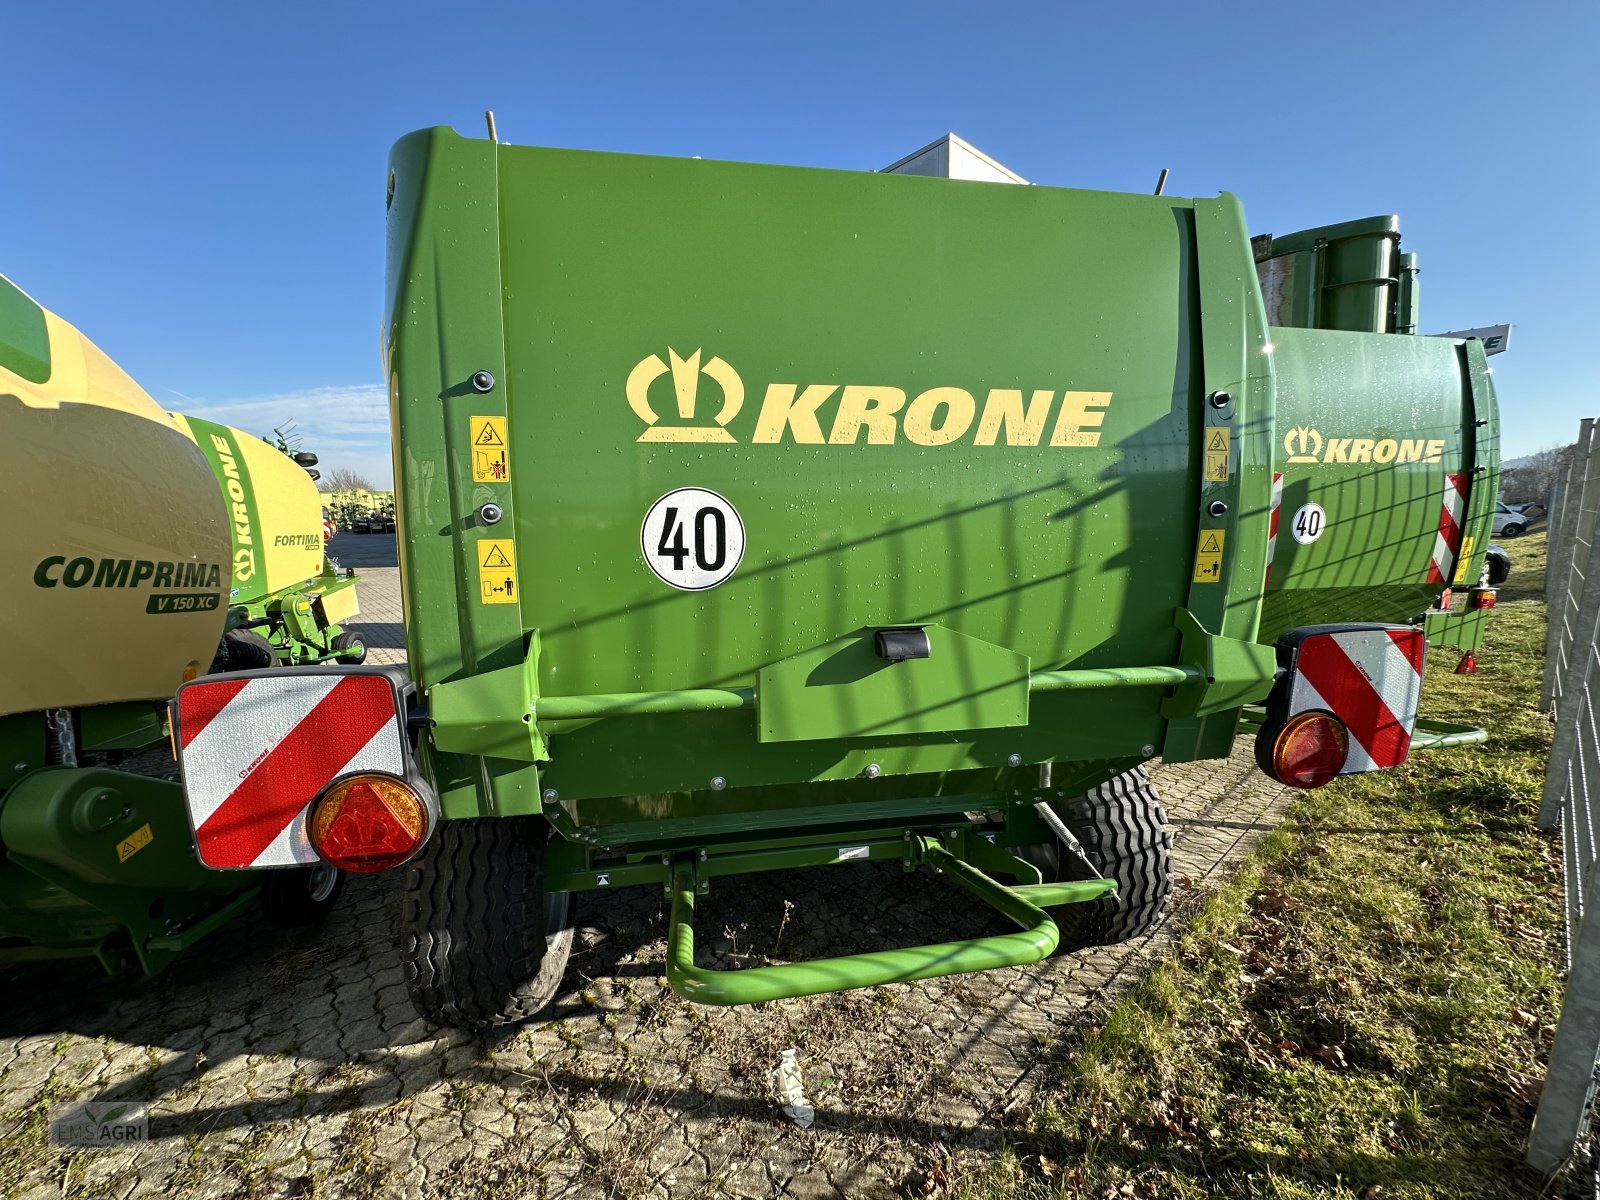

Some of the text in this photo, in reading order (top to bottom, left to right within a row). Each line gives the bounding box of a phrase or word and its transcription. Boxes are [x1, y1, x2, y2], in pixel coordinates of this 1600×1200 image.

[1481, 336, 1503, 349] E
[752, 383, 1113, 447] KRONE
[1323, 438, 1445, 463] KRONE
[210, 433, 253, 545] KRONE
[1296, 510, 1321, 537] 40
[274, 534, 320, 546] FORTIMA
[657, 506, 727, 572] 40
[33, 555, 221, 588] COMPRIMA
[157, 596, 214, 611] V 150 XC
[246, 748, 269, 773] KRONE
